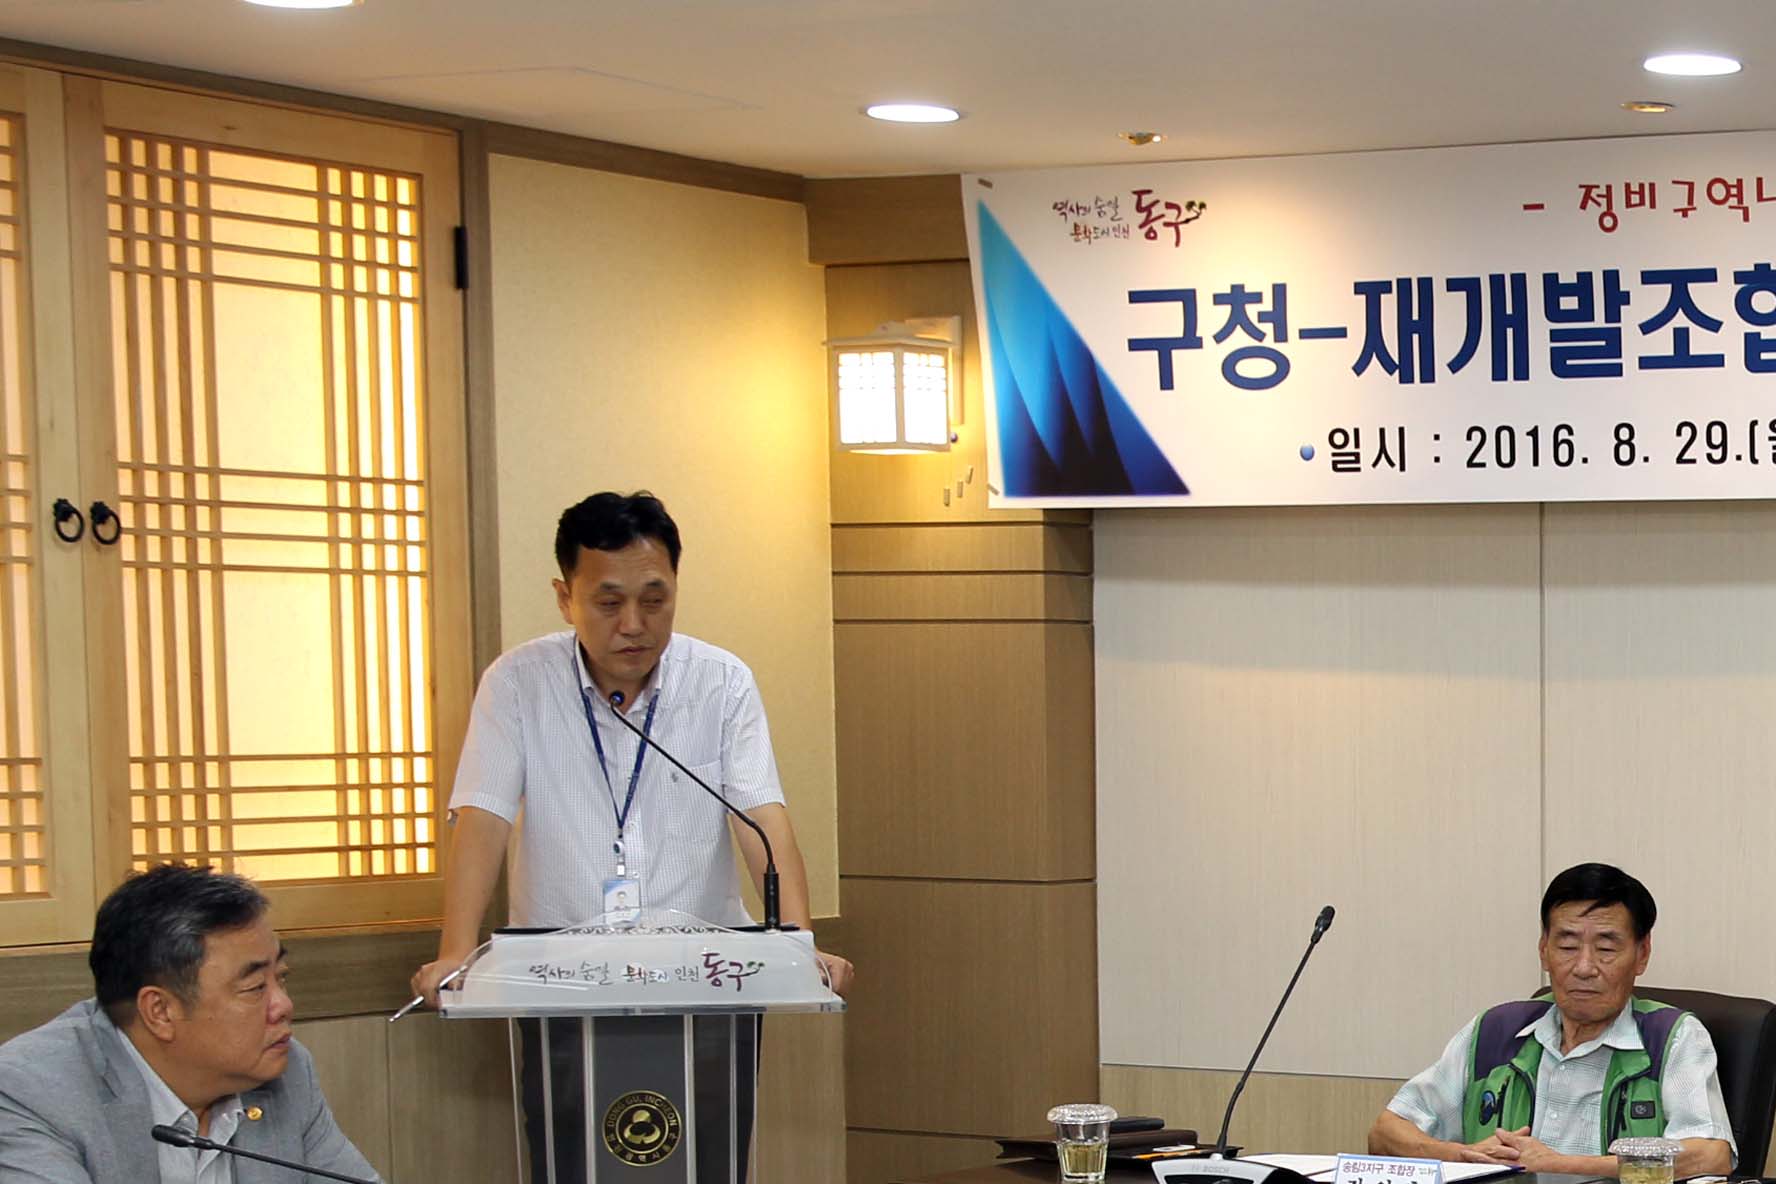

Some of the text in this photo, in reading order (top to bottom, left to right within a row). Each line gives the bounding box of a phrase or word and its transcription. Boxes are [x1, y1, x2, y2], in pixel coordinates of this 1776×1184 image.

[1131, 189, 1188, 248] 동구
[1327, 426, 1407, 473] 일시
[1465, 423, 1590, 469] 2016.
[1612, 421, 1651, 467] 8.
[702, 952, 756, 991] 동구
